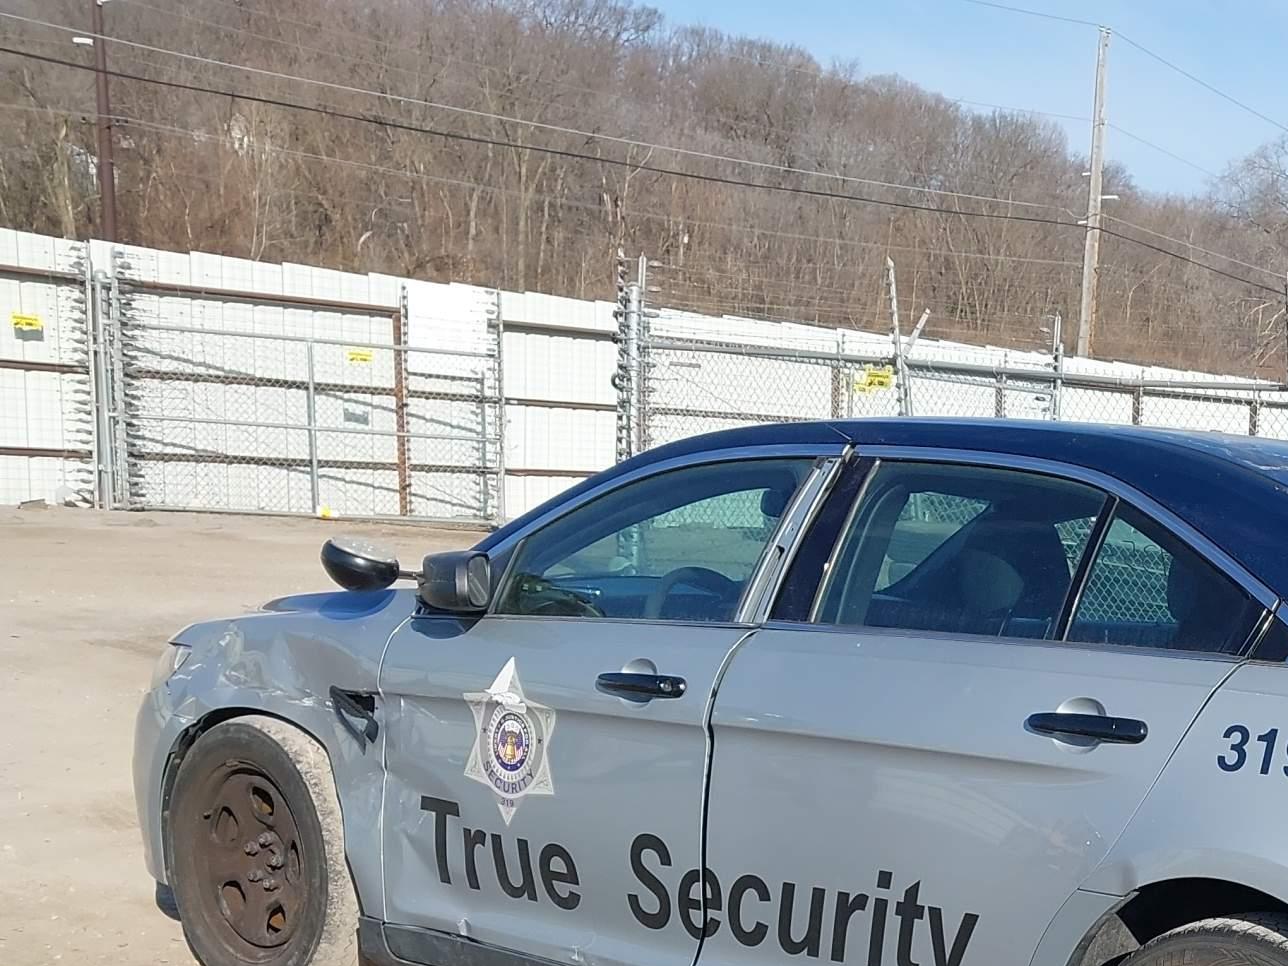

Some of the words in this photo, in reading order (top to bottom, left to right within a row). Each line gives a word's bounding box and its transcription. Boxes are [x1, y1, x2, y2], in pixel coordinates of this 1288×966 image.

[483, 760, 534, 795] SECURITY
[501, 799, 514, 808] 319
[419, 796, 581, 911] True
